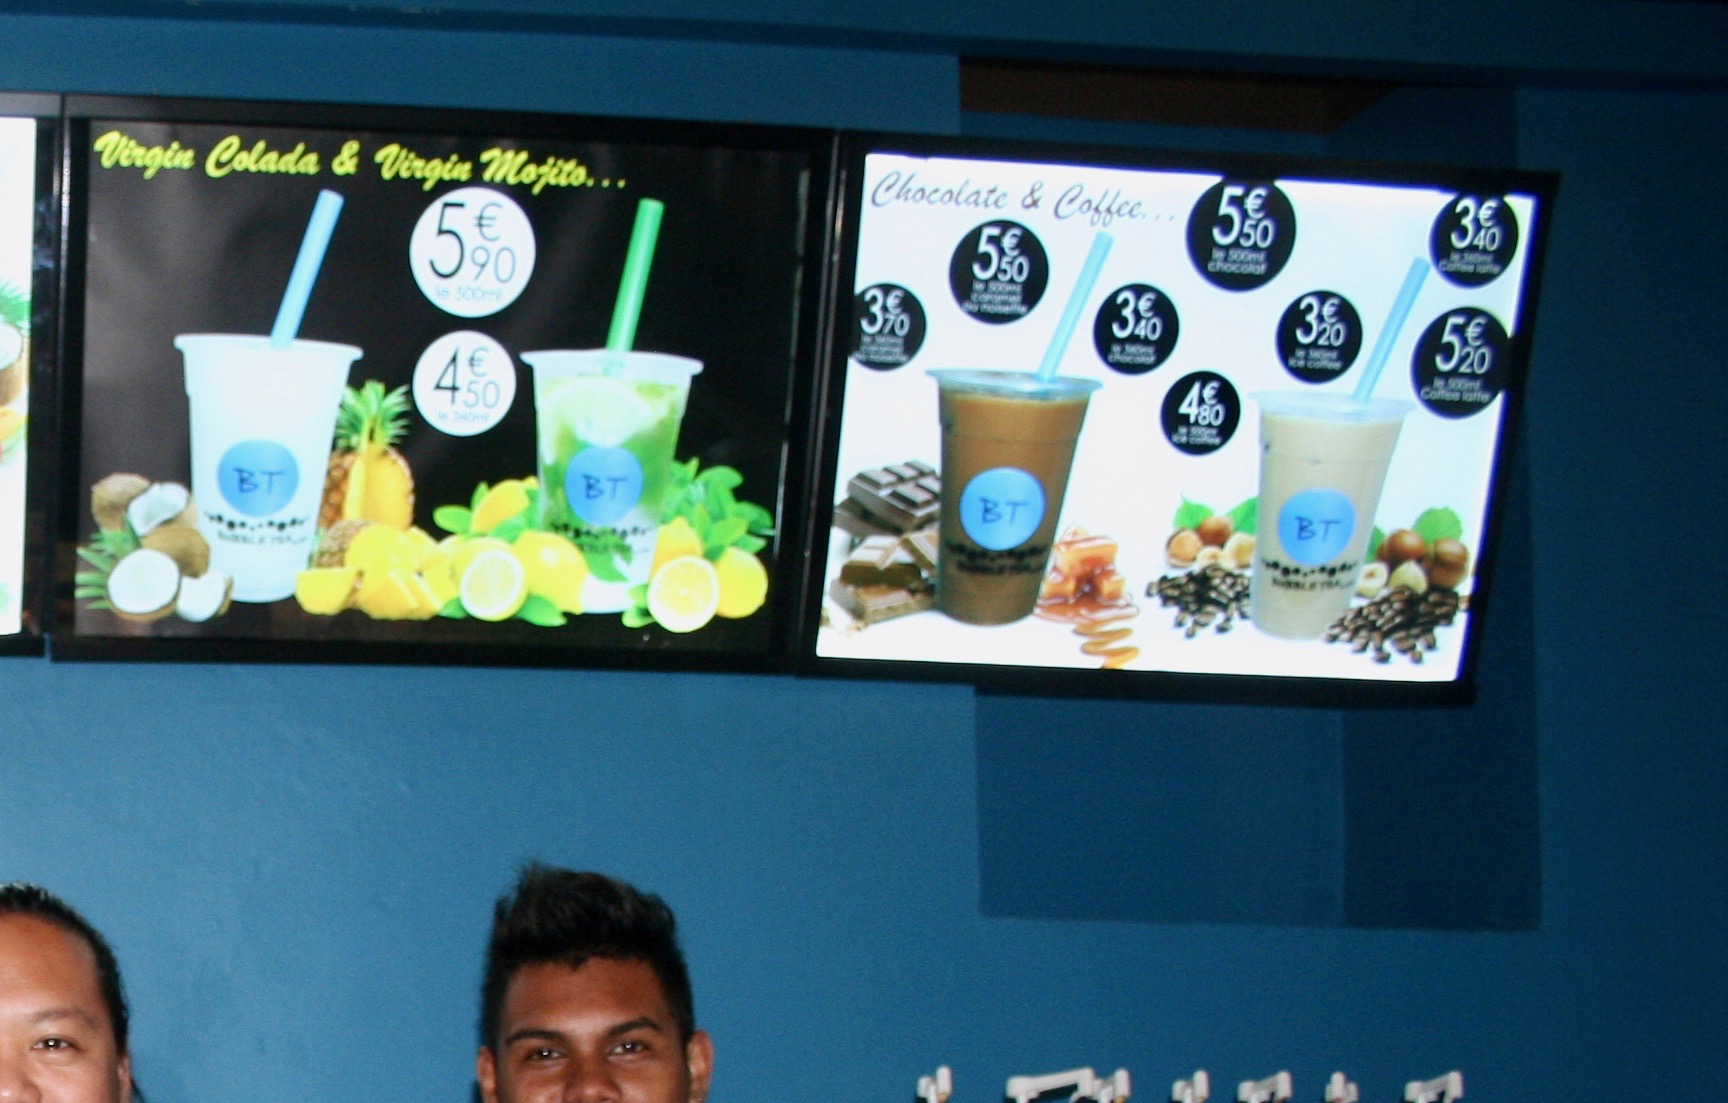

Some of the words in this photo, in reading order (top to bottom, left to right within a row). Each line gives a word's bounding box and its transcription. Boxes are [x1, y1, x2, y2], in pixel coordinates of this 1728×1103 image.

[93, 130, 195, 180] Virgin
[204, 134, 320, 178] Colada
[331, 140, 360, 176] &
[374, 143, 473, 192] Virgin
[871, 170, 1008, 209] Chocolate
[1021, 180, 1044, 210] &
[234, 468, 286, 495] BT
[582, 474, 628, 499] BT
[981, 498, 1029, 525] BT
[1295, 516, 1340, 542] BT
